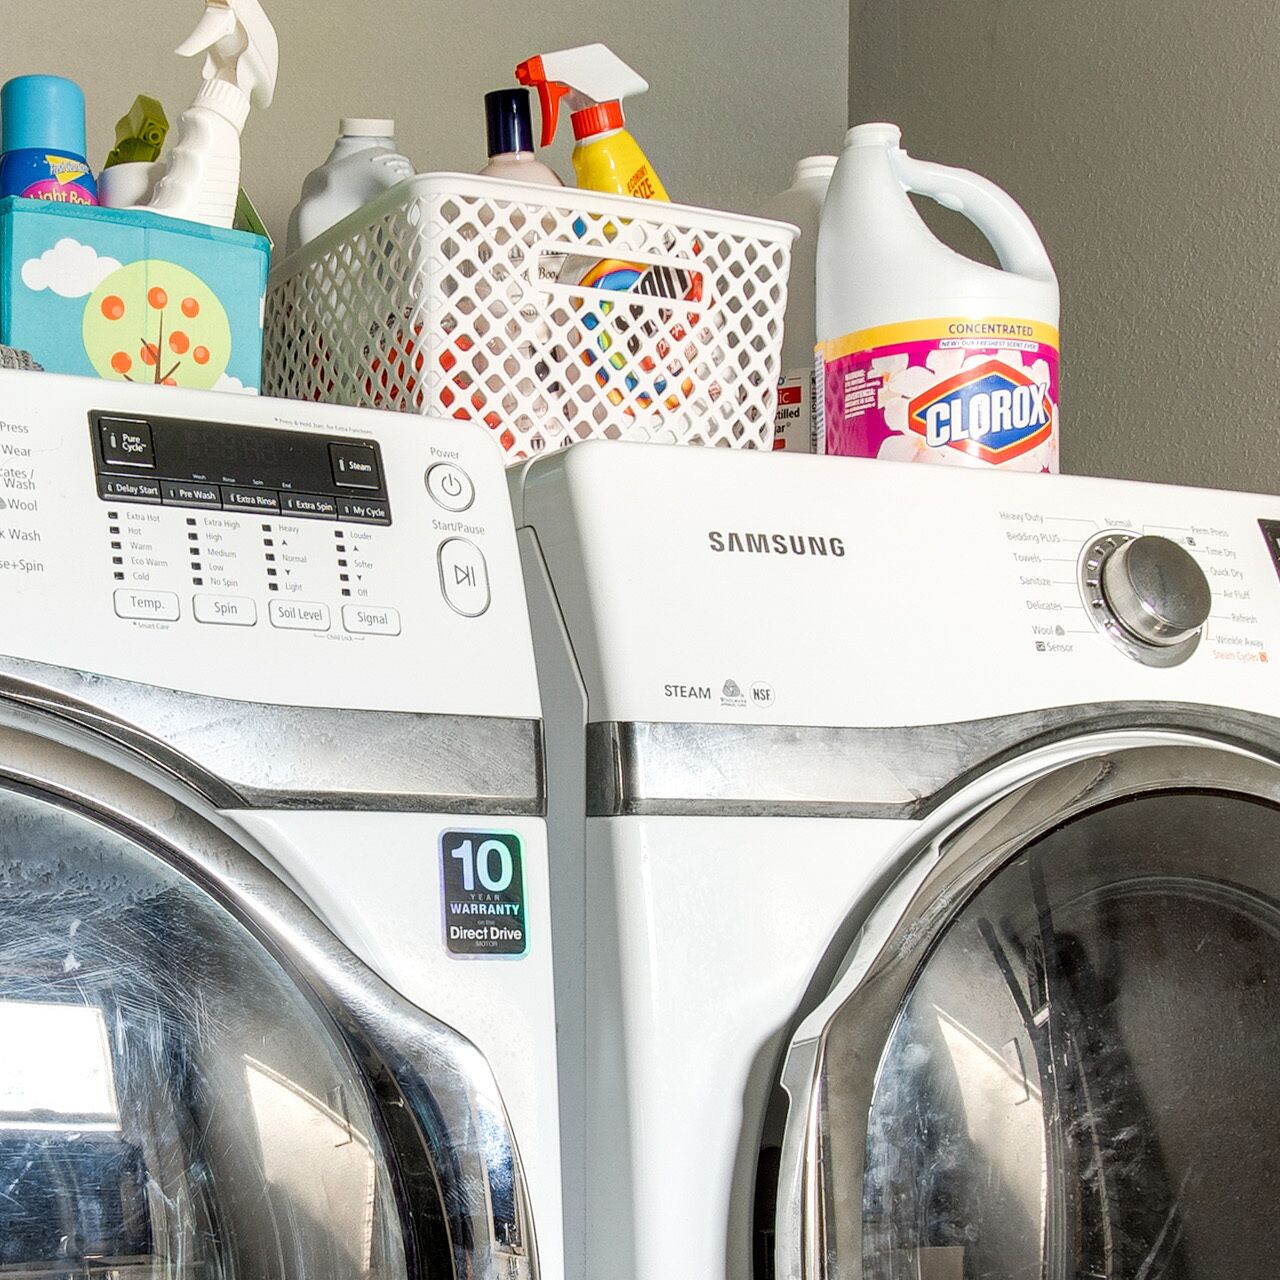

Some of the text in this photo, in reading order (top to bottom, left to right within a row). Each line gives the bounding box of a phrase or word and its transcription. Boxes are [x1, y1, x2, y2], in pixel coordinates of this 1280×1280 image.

[634, 177, 655, 199] SIZE
[948, 323, 1033, 337] CONCENTRATED
[926, 383, 1047, 447] CLOROX
[0, 420, 30, 434] Press
[122, 433, 141, 443] Pure
[1, 445, 32, 457] Wear
[429, 446, 460, 460] Power
[348, 460, 372, 472] Steam
[3, 477, 36, 491] Wash
[116, 483, 158, 495] Delay Start
[179, 489, 217, 500] Pre Wash
[236, 494, 277, 506] Extra Rinse
[7, 499, 38, 511] Wool
[296, 499, 334, 512] Extra Spin
[353, 505, 385, 517] My Cycle
[126, 511, 161, 523] Extra Hot
[999, 511, 1044, 524] Heavy Duty
[1105, 518, 1132, 528] Normal
[204, 517, 241, 530] Extra High
[278, 524, 300, 534] Heavy
[432, 518, 486, 536] Start/Pause
[8, 528, 41, 542] Wash
[128, 527, 142, 535] Hot
[205, 532, 223, 542] High
[350, 531, 372, 540] Louder
[1006, 531, 1061, 544] Bedding PLUS
[130, 542, 153, 551] Warm
[708, 531, 845, 557] SAMSUNG
[207, 548, 237, 558] Medium
[282, 553, 308, 563] Normal
[1013, 553, 1042, 563] Towels
[130, 556, 168, 567] Eco Warm
[209, 563, 224, 572] Low
[354, 560, 373, 569] Softer
[132, 572, 150, 581] Cold
[1210, 567, 1244, 580] Quick Dry
[210, 577, 239, 588] No Spin
[1020, 576, 1051, 586] Sanitize
[285, 582, 303, 593] Light
[357, 588, 369, 597] Off
[130, 596, 165, 612] Temp.
[214, 601, 238, 616] Spin
[1026, 600, 1062, 611] Delicates
[278, 606, 323, 621] Soil Level
[357, 611, 389, 626] Signal
[1032, 625, 1053, 635] Wool
[1047, 642, 1073, 652] Sensor
[1215, 635, 1264, 649] Wrinkle Away
[1212, 649, 1236, 660] Steam
[664, 684, 712, 700] STEAM
[451, 839, 513, 892] 10
[470, 893, 500, 901] YEAR
[450, 903, 520, 915] WARRANTY
[450, 926, 522, 940] Direct Drive
